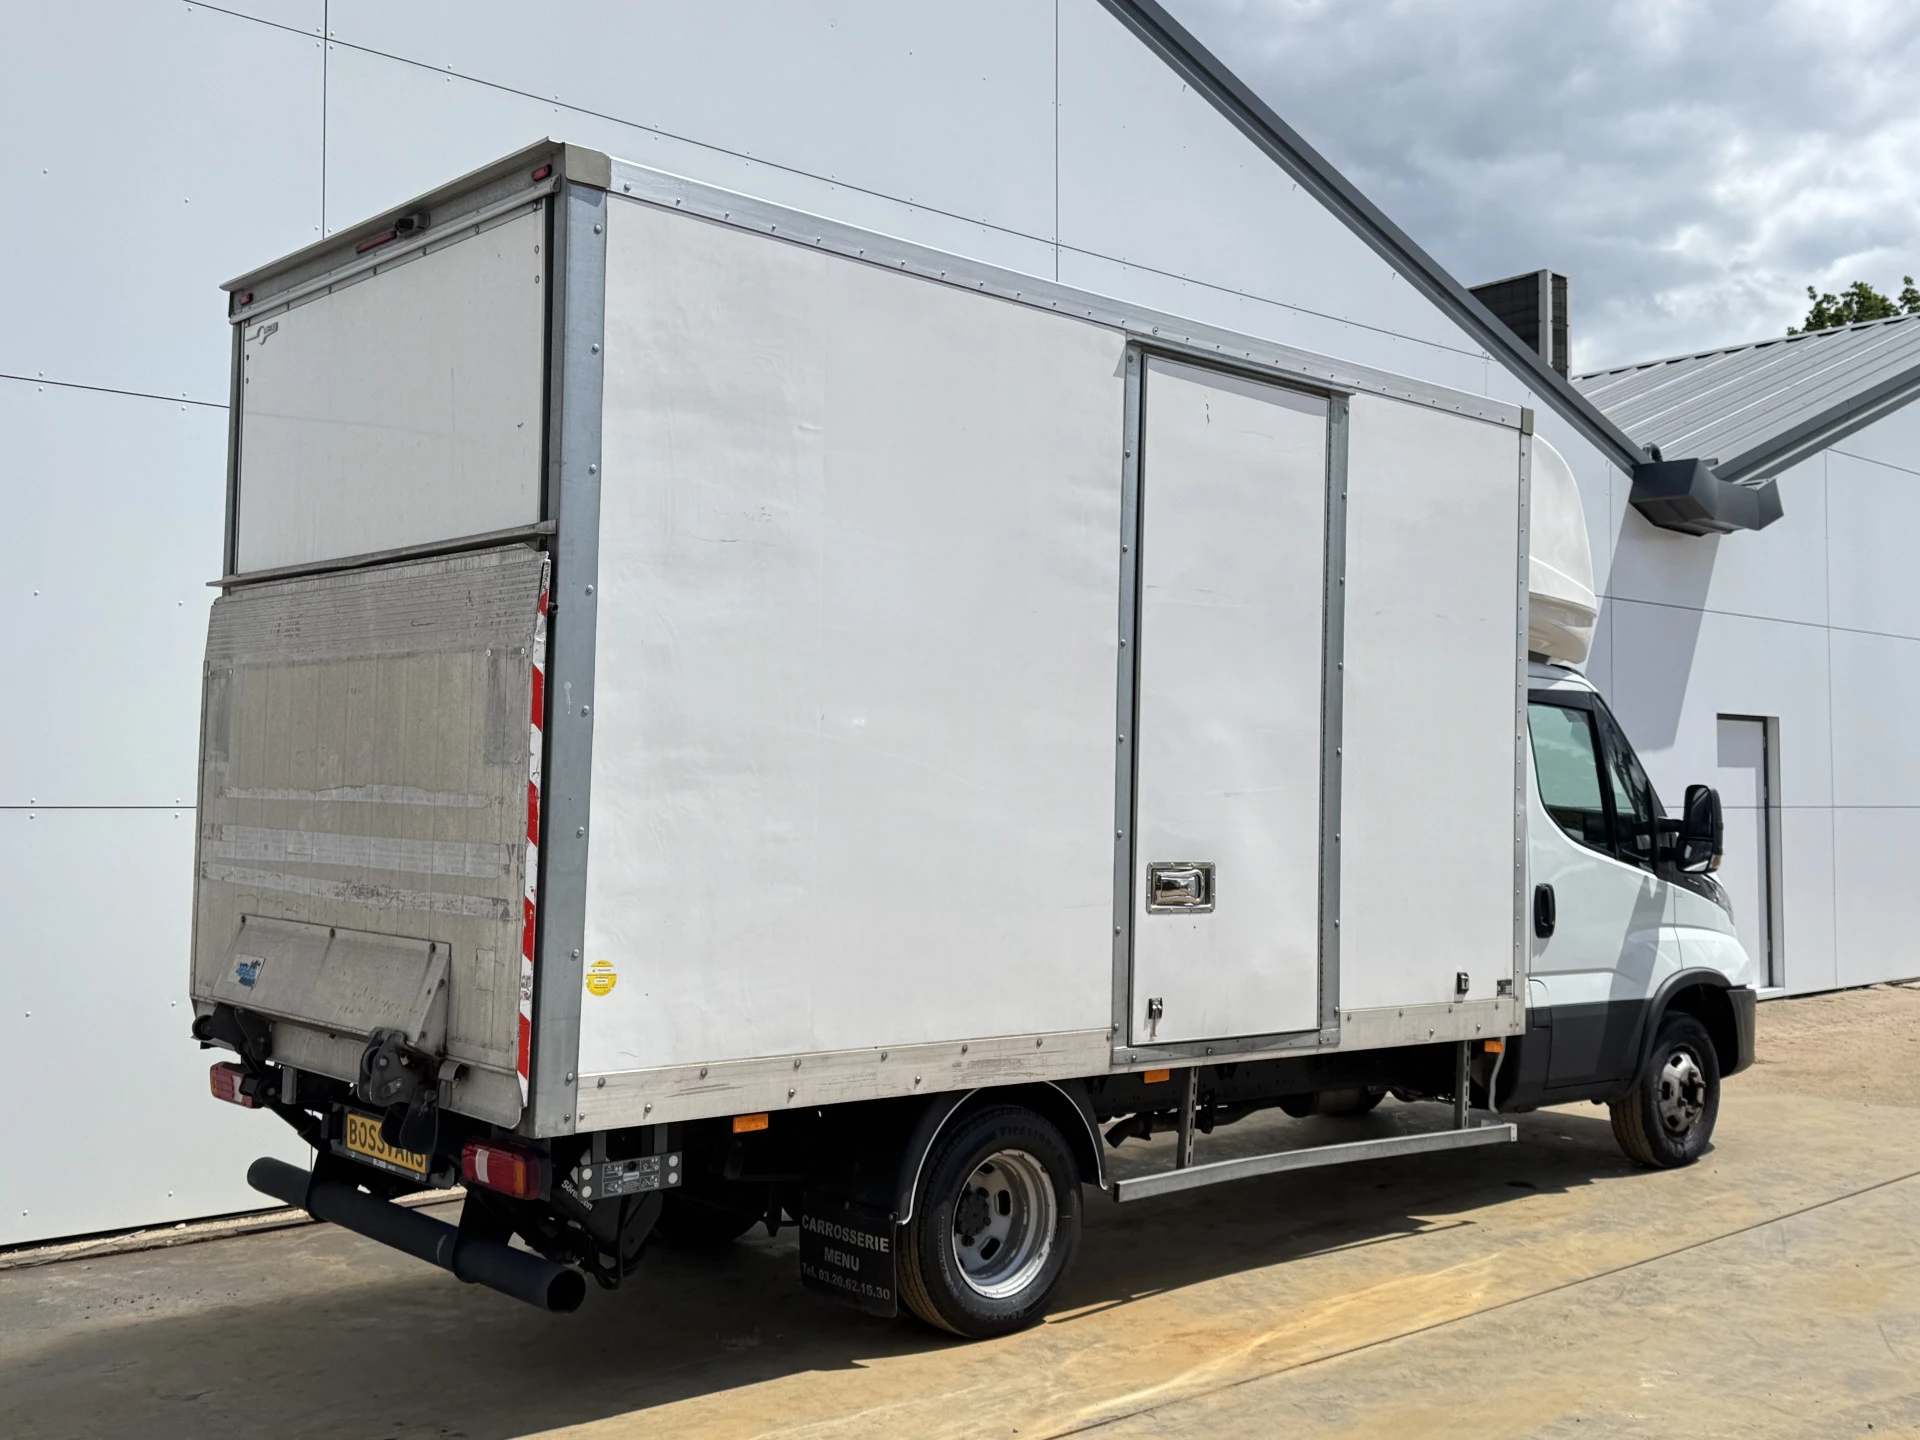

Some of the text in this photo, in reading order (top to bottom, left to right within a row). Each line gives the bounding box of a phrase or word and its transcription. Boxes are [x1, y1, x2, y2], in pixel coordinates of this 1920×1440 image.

[561, 1179, 594, 1211] Söreen
[801, 1214, 890, 1253] CARROSSERIE
[824, 1246, 860, 1272] MENU
[818, 1268, 891, 1300] 03.20.62.15.30
